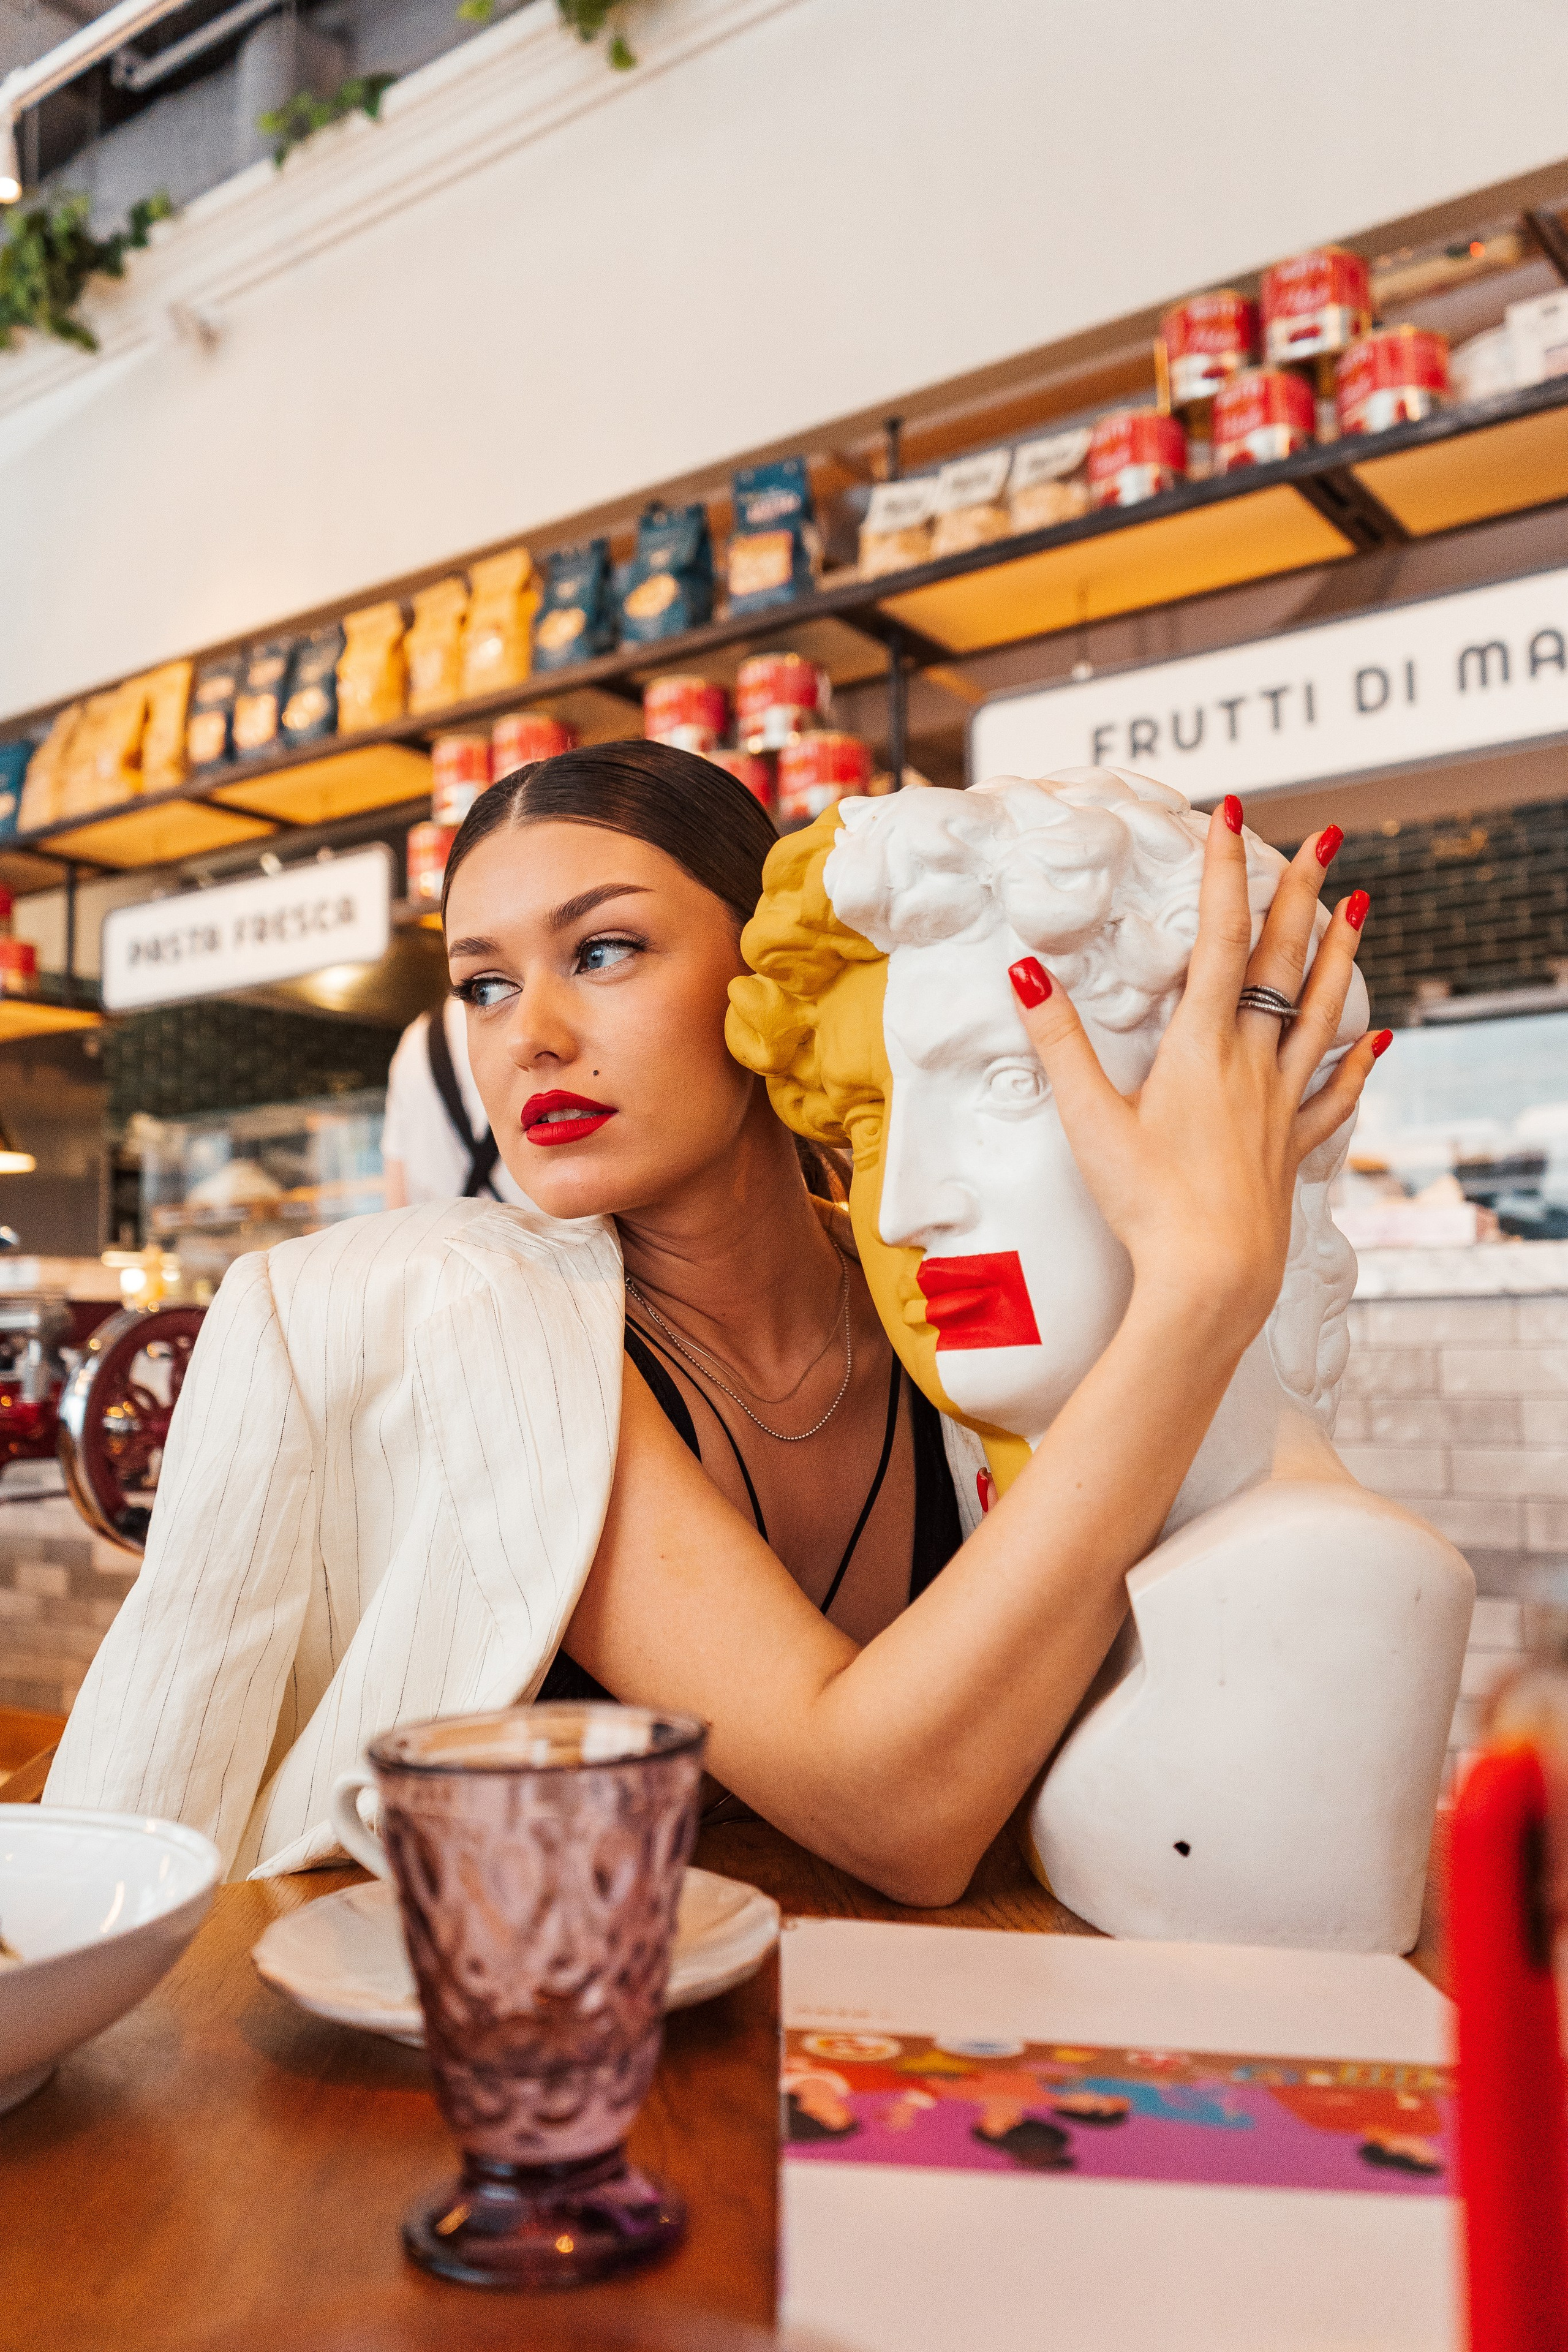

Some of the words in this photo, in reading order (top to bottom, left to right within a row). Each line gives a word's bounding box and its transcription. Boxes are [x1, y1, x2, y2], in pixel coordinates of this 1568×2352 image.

[1091, 681, 1316, 766] FRUTTI
[1354, 660, 1416, 715] DI
[1457, 627, 1568, 693] MA
[127, 922, 221, 969] PASTA
[233, 895, 357, 948] FRESCA
